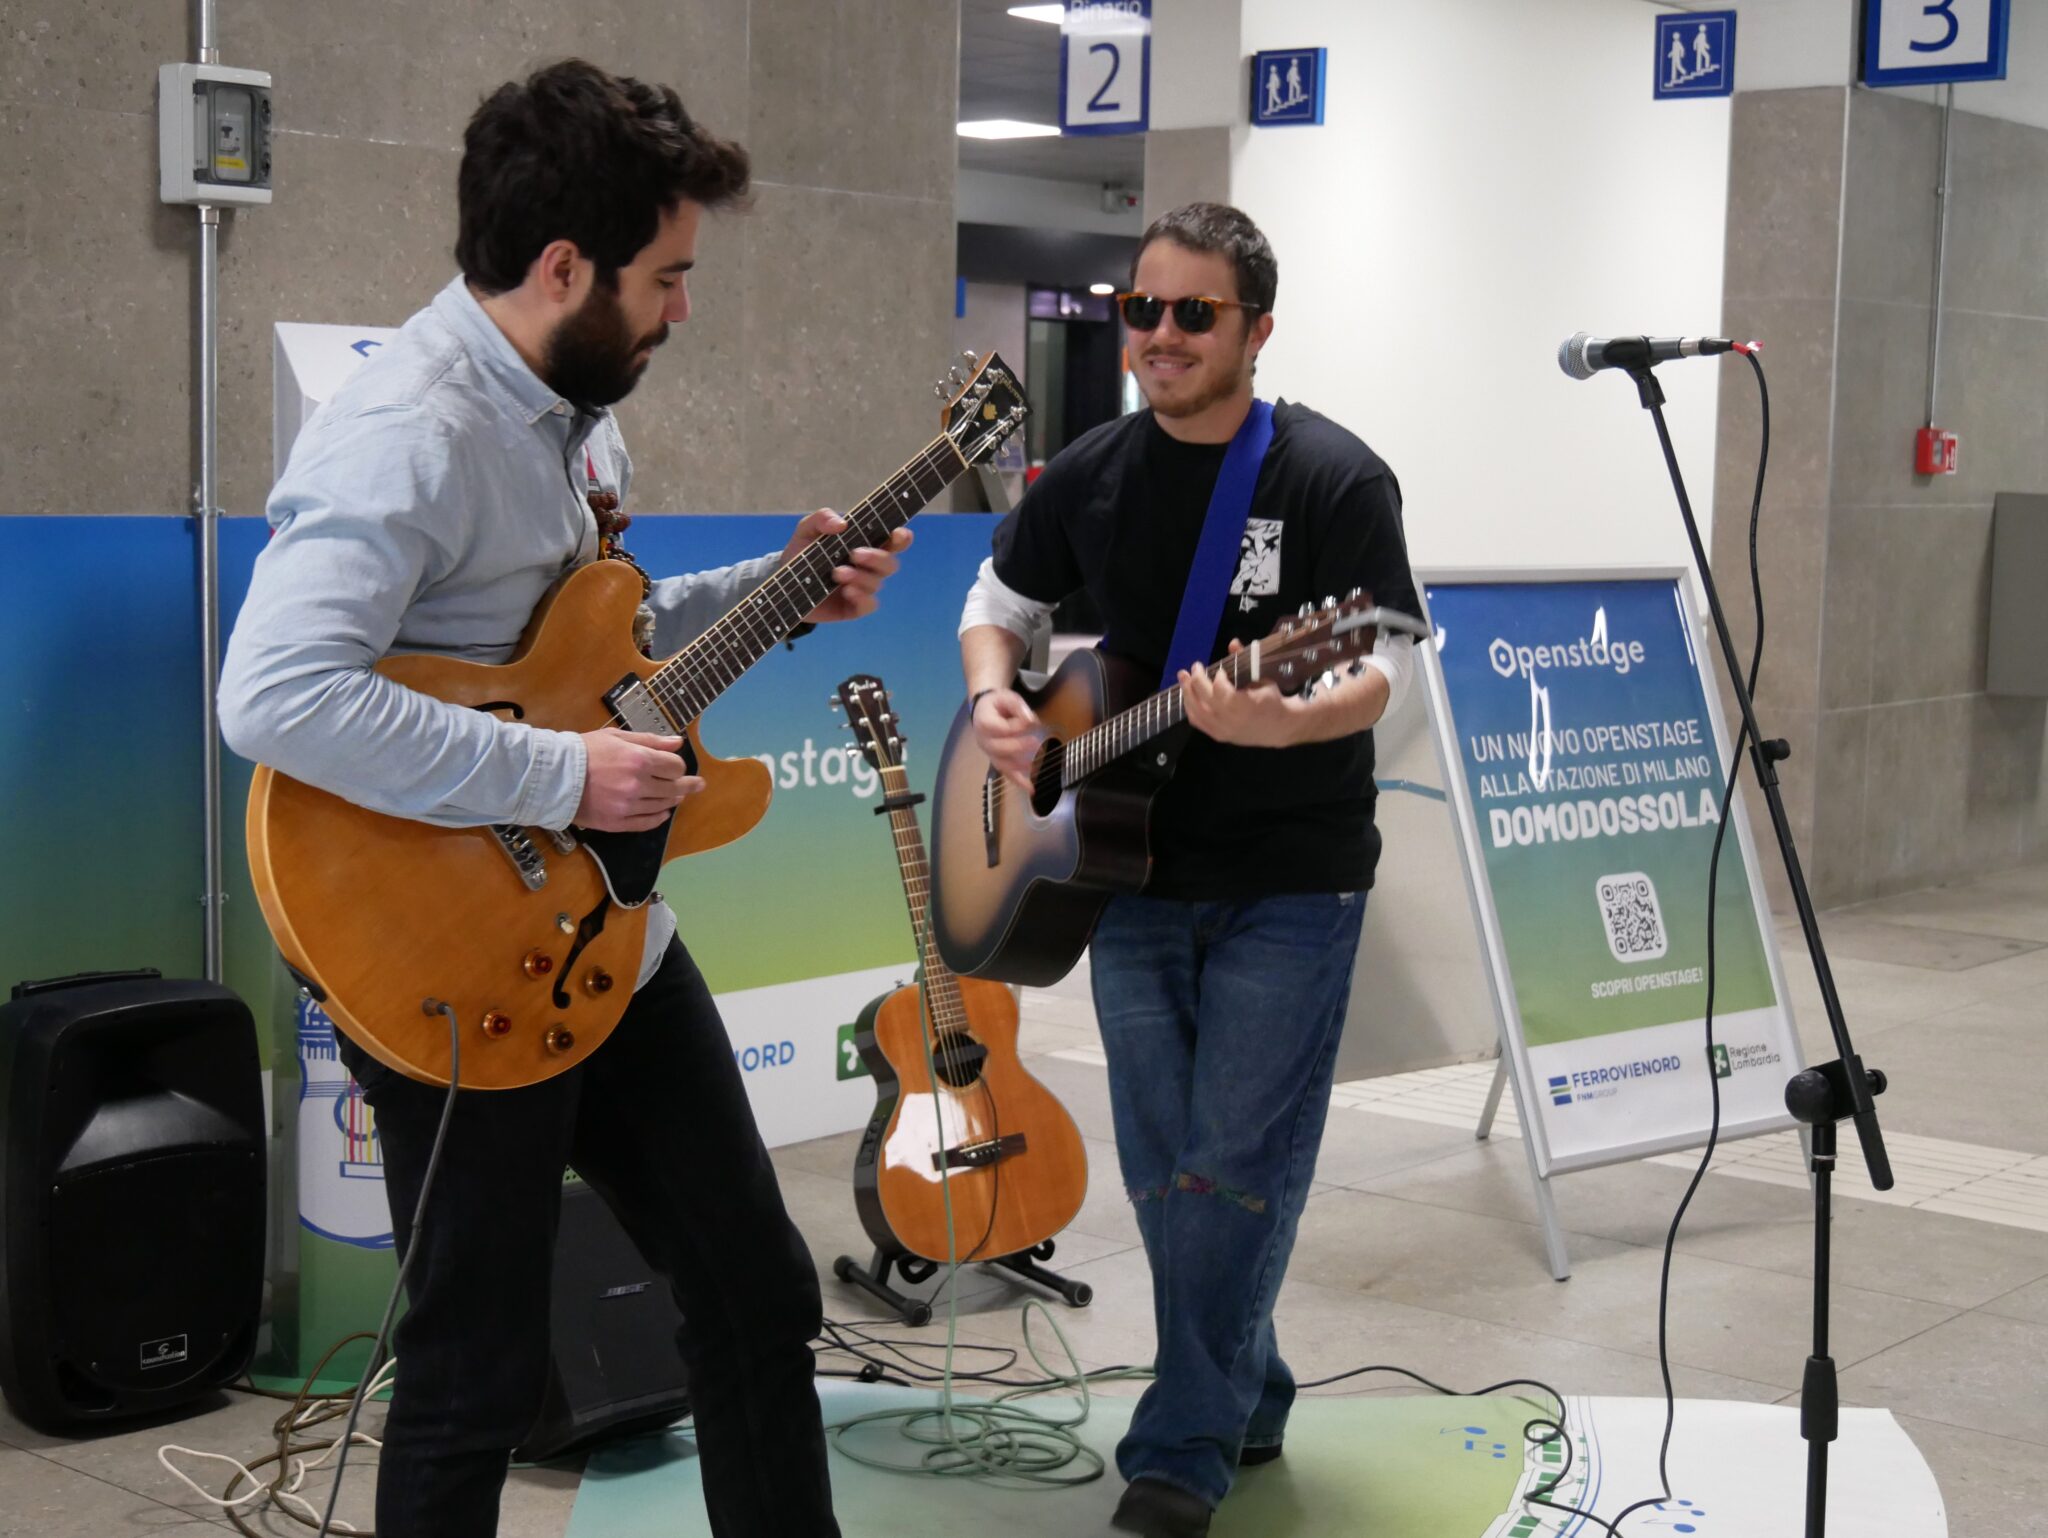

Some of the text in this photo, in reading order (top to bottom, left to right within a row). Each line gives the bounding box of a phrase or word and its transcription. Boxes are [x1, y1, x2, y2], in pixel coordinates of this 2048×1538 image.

[1087, 43, 1121, 113] 2
[1488, 637, 1645, 680] Openstage
[1471, 734, 1504, 763] UN
[1583, 720, 1703, 753] OPENSTAGE
[1481, 772, 1531, 799] ALLA
[1622, 762, 1641, 786] DI
[1642, 755, 1711, 783] MILANO
[1489, 789, 1720, 849] DOMODOSSOLA
[1591, 967, 1704, 998] SCOPRI OPENSTAGE!
[1572, 1055, 1681, 1088] FERROVIENORD
[1729, 1043, 1767, 1058] Regione
[1732, 1054, 1781, 1071] Lombardia
